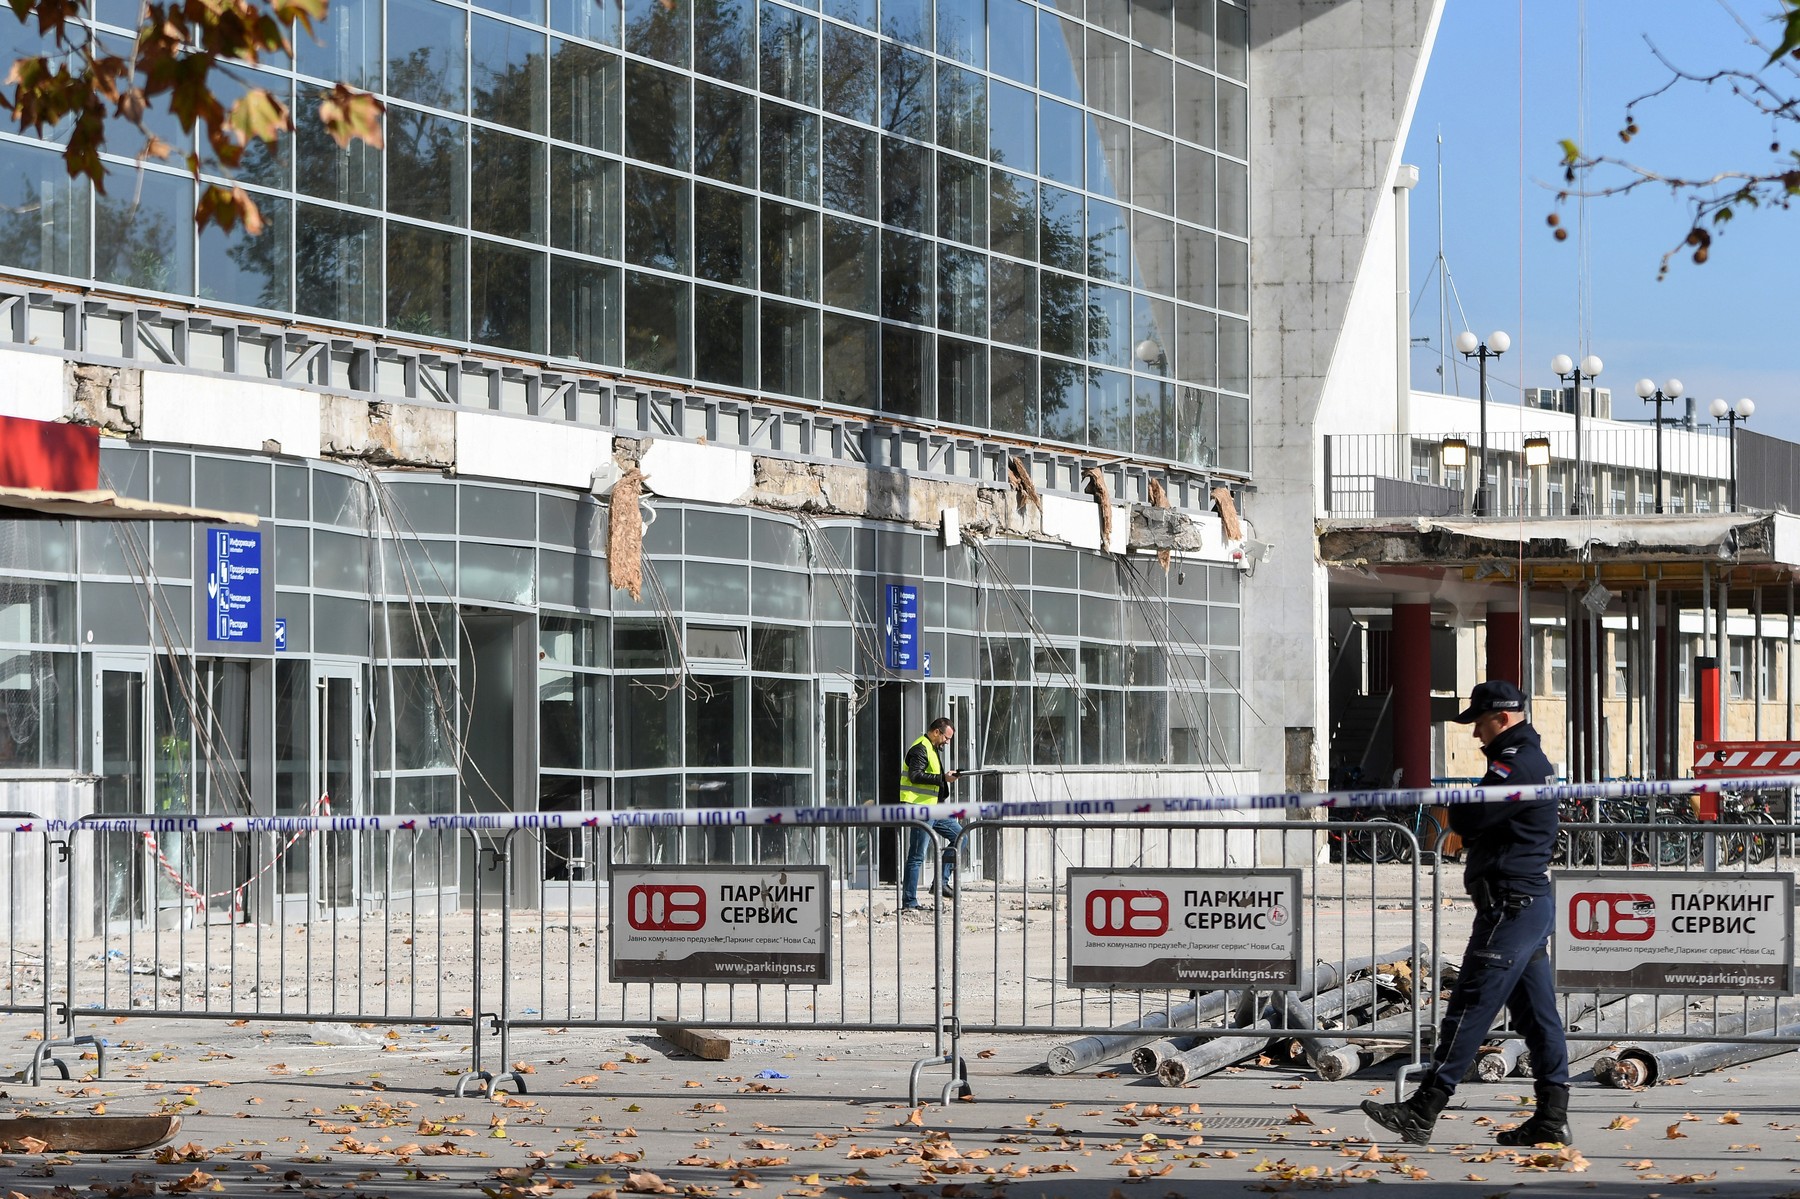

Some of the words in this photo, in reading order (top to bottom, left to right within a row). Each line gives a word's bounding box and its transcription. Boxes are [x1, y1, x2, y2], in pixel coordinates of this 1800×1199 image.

[1671, 893, 1775, 912] ПАРКИНГ
[720, 907, 798, 924] СЕРВИС
[1184, 912, 1266, 930] СЕРВИС
[1671, 916, 1756, 934] СЕРВИС
[627, 935, 647, 944] Јавно
[648, 936, 685, 944] комунално
[803, 937, 816, 945] Сад
[1107, 942, 1147, 950] комунално
[1271, 943, 1285, 952] Сад
[1739, 947, 1760, 955] Нови
[1761, 948, 1776, 956] Сад
[715, 962, 816, 975] www.parkingns.rs
[1178, 967, 1285, 981] www.parkingns.rs
[1665, 973, 1775, 987] www.parkingns.rs
